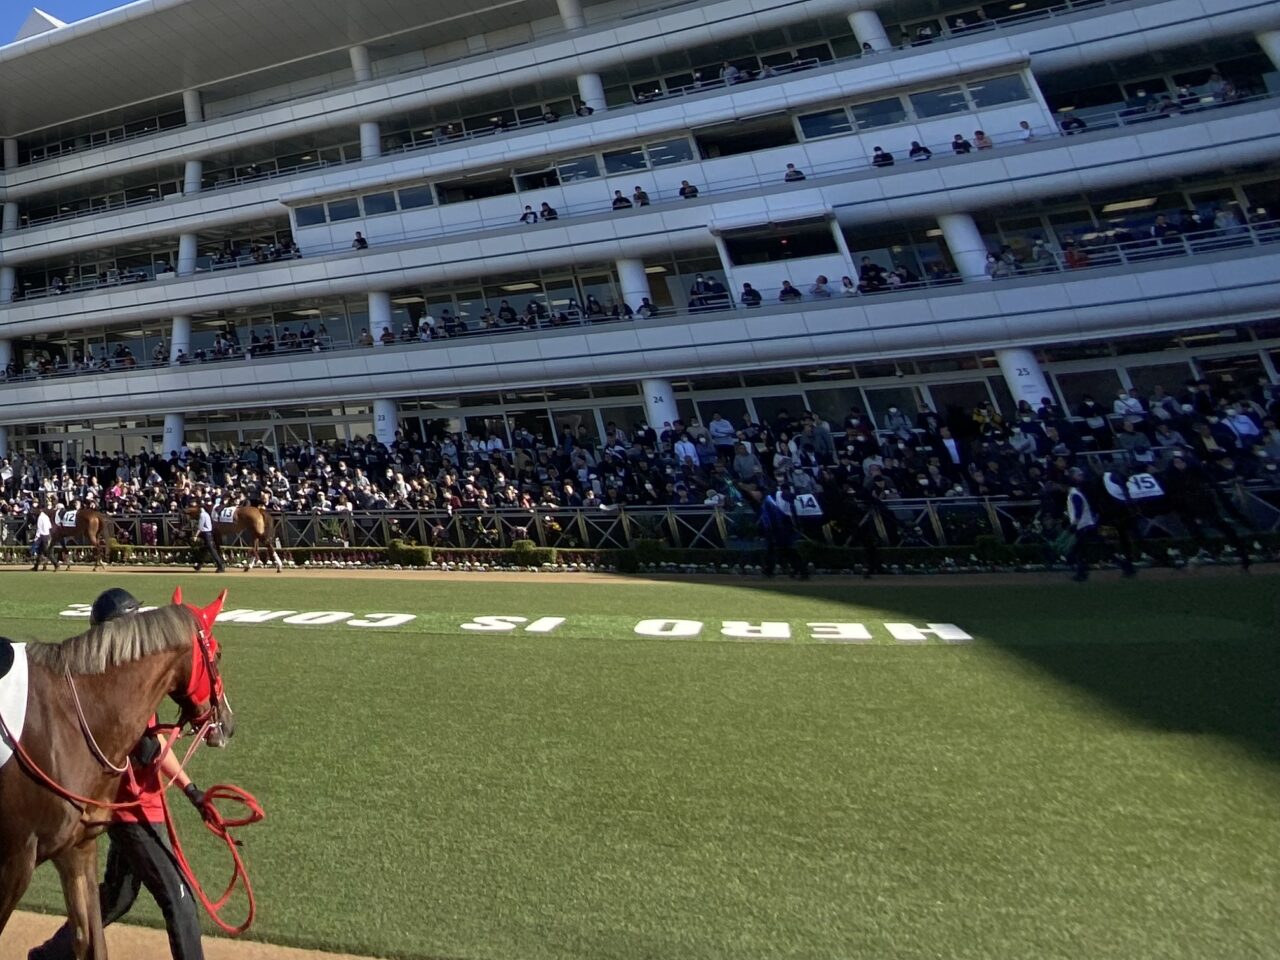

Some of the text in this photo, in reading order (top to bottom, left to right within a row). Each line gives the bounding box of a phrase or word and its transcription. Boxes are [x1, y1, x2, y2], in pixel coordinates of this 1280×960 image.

[1016, 368, 1030, 377] 25
[1134, 476, 1154, 489] 15
[800, 496, 816, 509] 14
[65, 513, 75, 522] 12
[460, 615, 566, 633] IS
[634, 618, 974, 640] HERO
